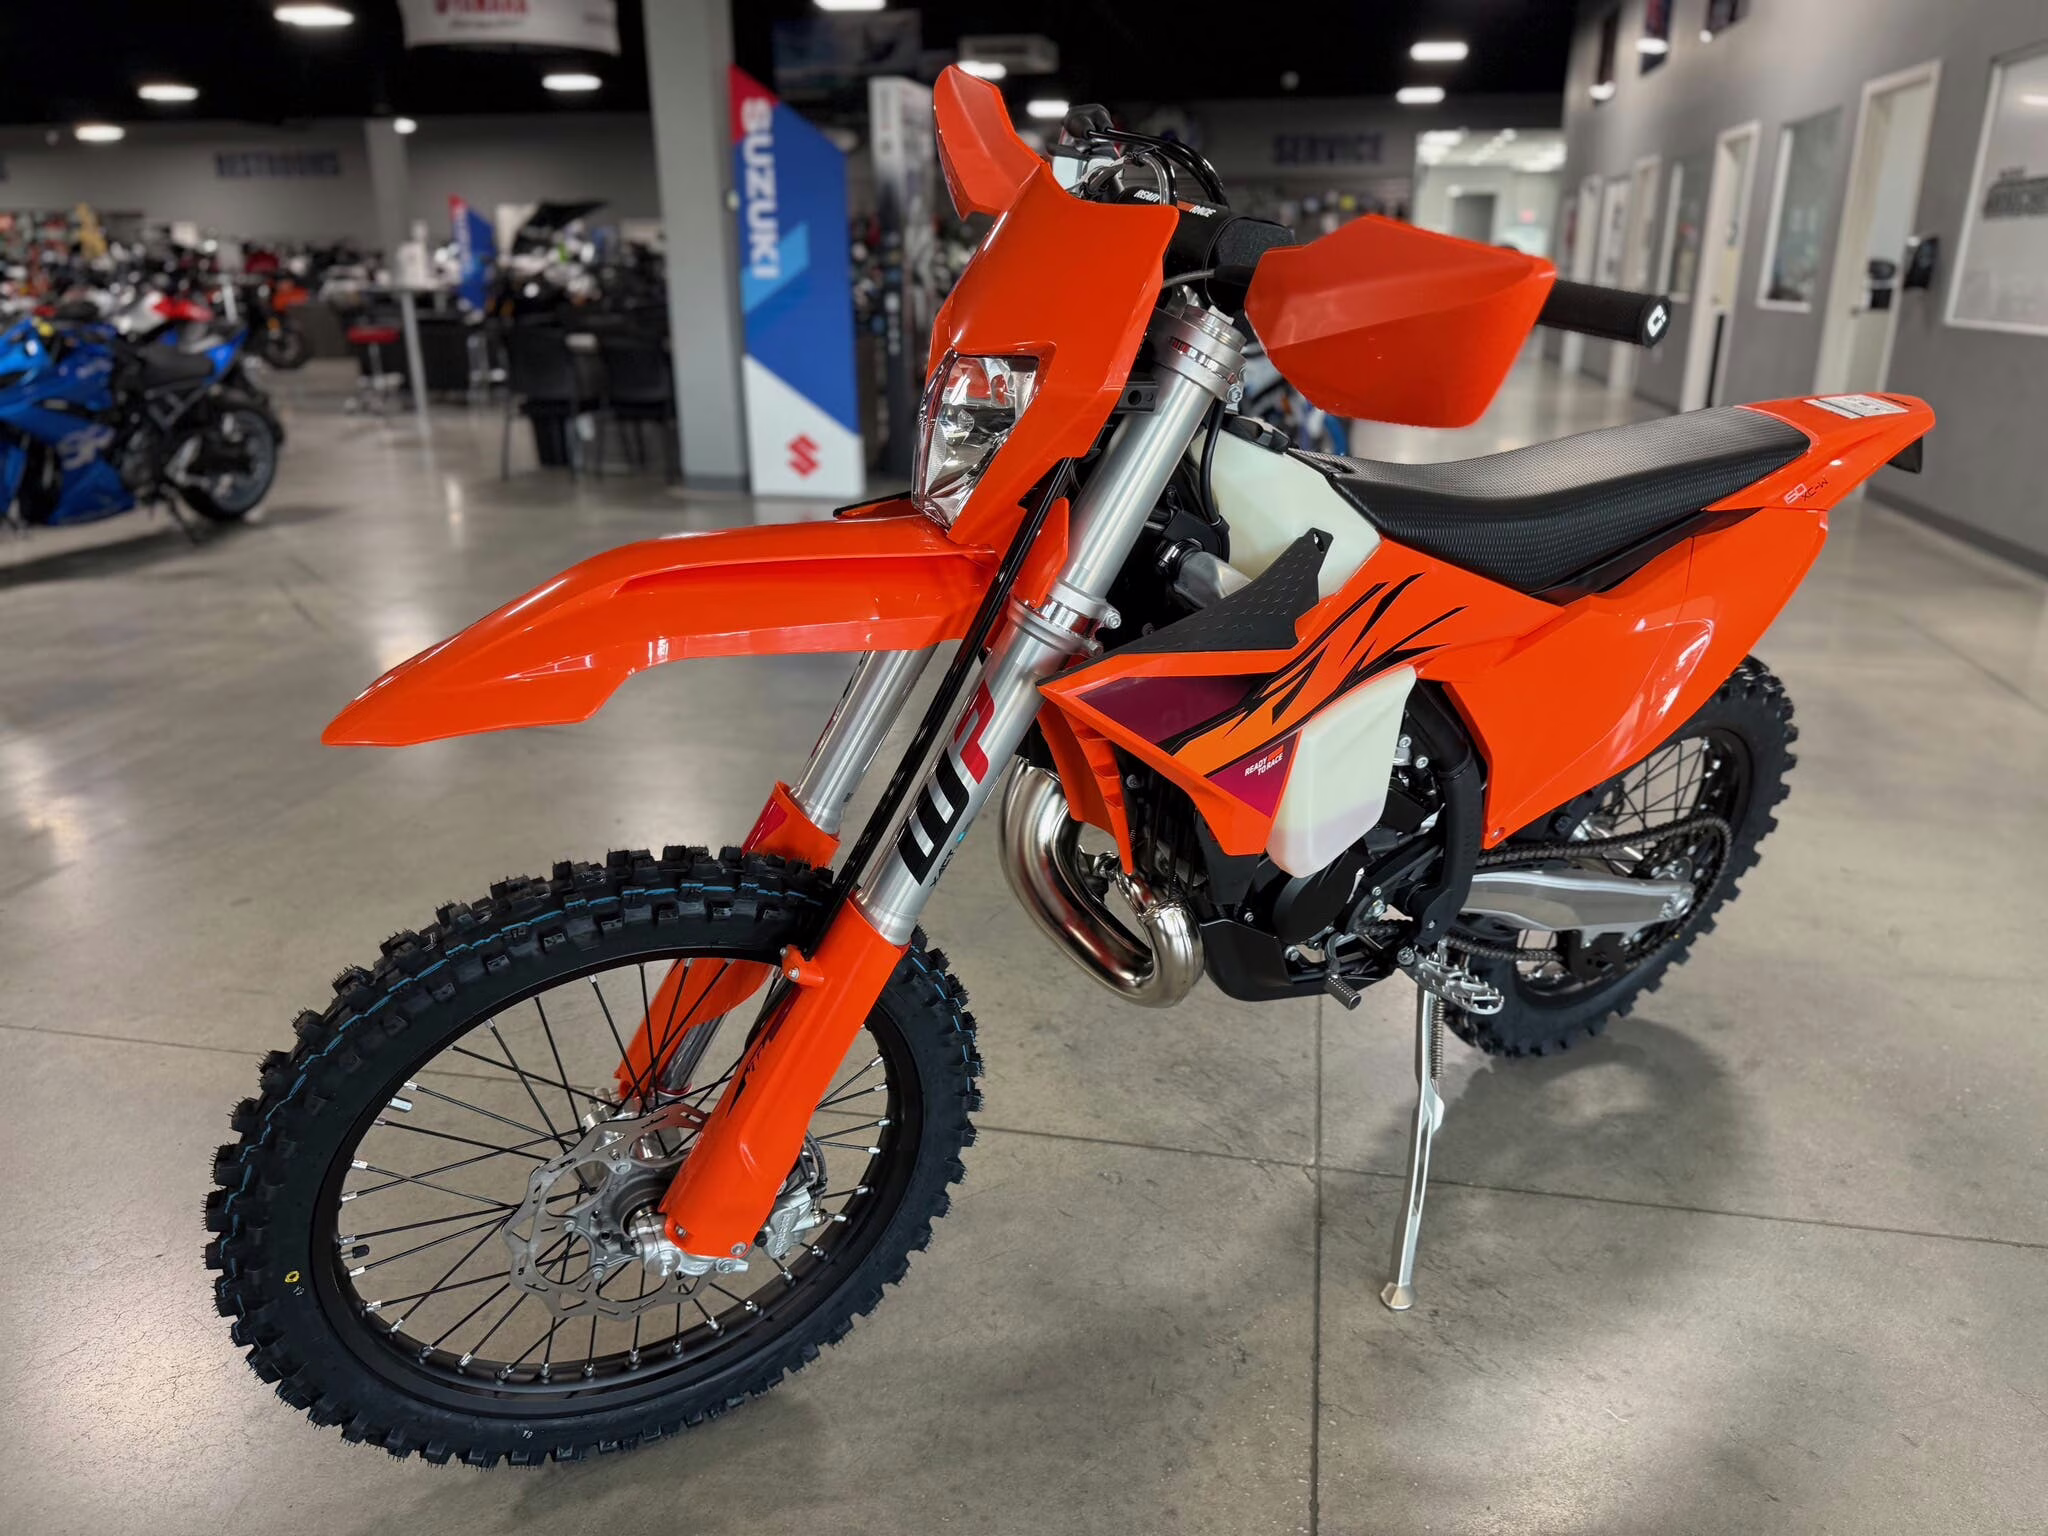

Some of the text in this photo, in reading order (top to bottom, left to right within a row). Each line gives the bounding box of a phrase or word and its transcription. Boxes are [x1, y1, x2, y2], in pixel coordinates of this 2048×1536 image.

[741, 97, 781, 279] SUZUKI
[1189, 205, 1216, 217] RACE
[1245, 757, 1267, 776] READY
[1257, 753, 1283, 776] TO RACE
